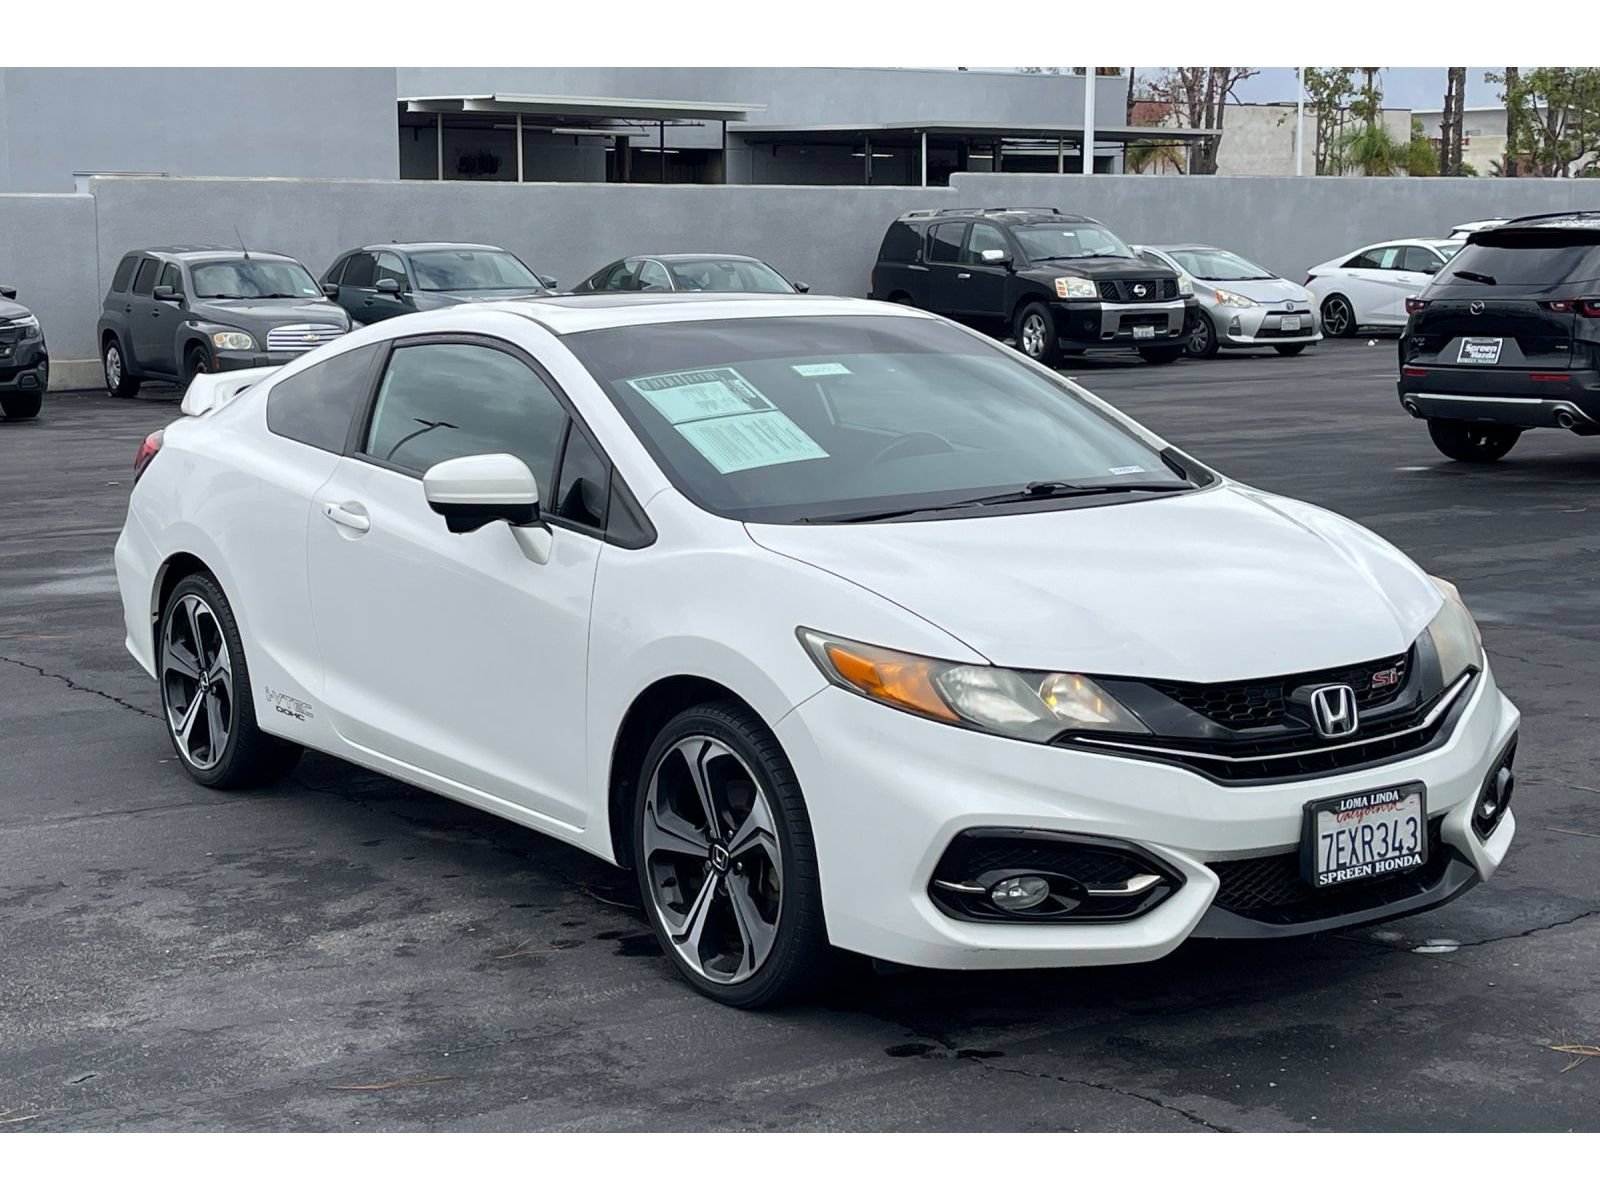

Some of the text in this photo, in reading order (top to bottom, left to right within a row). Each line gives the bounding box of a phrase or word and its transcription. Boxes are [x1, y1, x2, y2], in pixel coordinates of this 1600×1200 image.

[1465, 343, 1498, 353] Spreen
[1340, 791, 1399, 811] LOMA LINDA
[1322, 816, 1418, 872] 7EXR343
[1319, 854, 1422, 885] SPREEN HONDA
